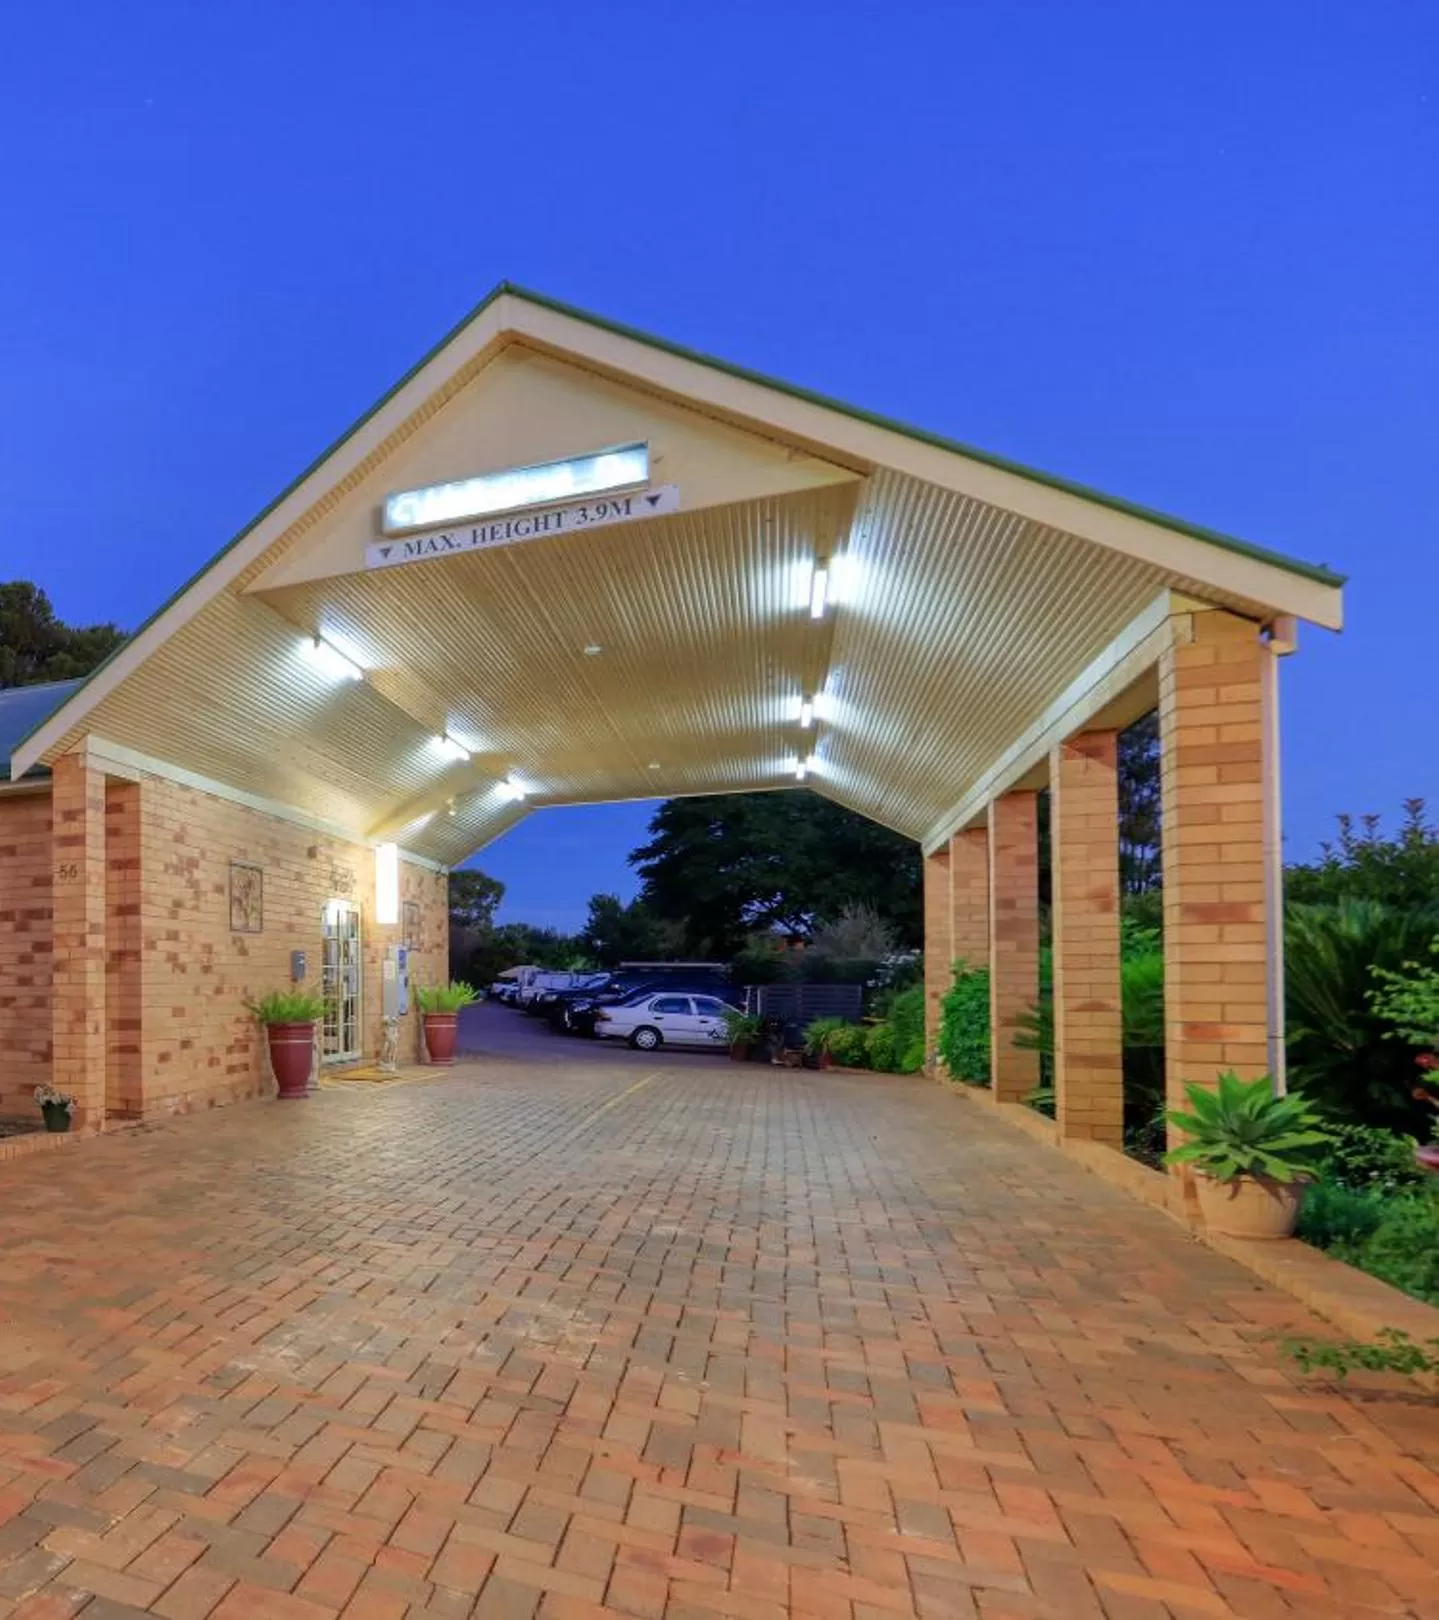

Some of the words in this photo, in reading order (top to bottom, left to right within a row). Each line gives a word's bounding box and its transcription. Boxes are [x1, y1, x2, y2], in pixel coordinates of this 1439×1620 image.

[403, 532, 461, 558] MAX.
[471, 510, 570, 545] HEIGHT
[575, 497, 633, 525] 3.9M
